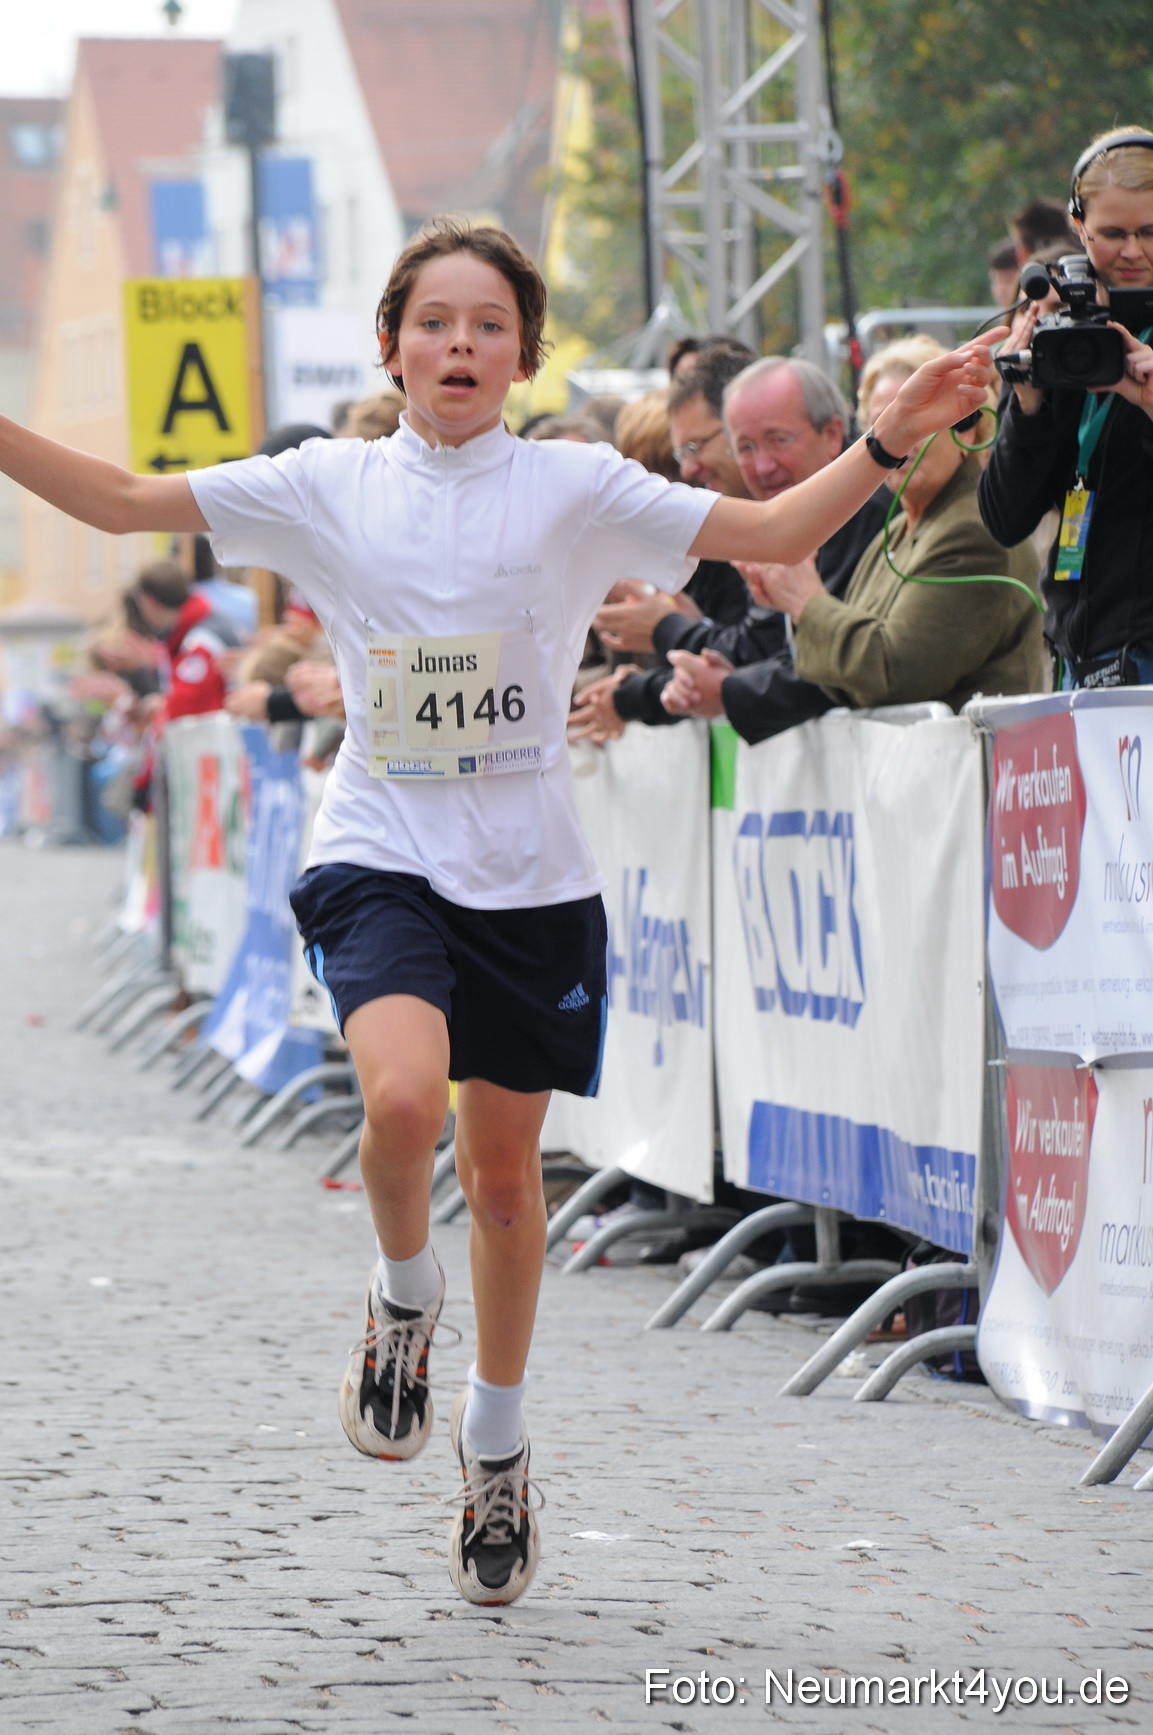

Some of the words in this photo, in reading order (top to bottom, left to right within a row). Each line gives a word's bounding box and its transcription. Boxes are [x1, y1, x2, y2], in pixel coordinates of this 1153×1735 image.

[138, 285, 245, 322] Block
[162, 342, 231, 434] A
[411, 646, 478, 673] Jonas
[373, 688, 383, 709] J
[415, 684, 526, 730] 4146
[478, 747, 541, 766] PFLEIDERER
[996, 759, 1016, 812] Wir
[1017, 743, 1072, 810] verkaufen
[1002, 837, 1019, 890] im
[733, 810, 866, 1031] BOCK
[1015, 1099, 1036, 1153] Wir
[1028, 1173, 1077, 1253] Auftrag!
